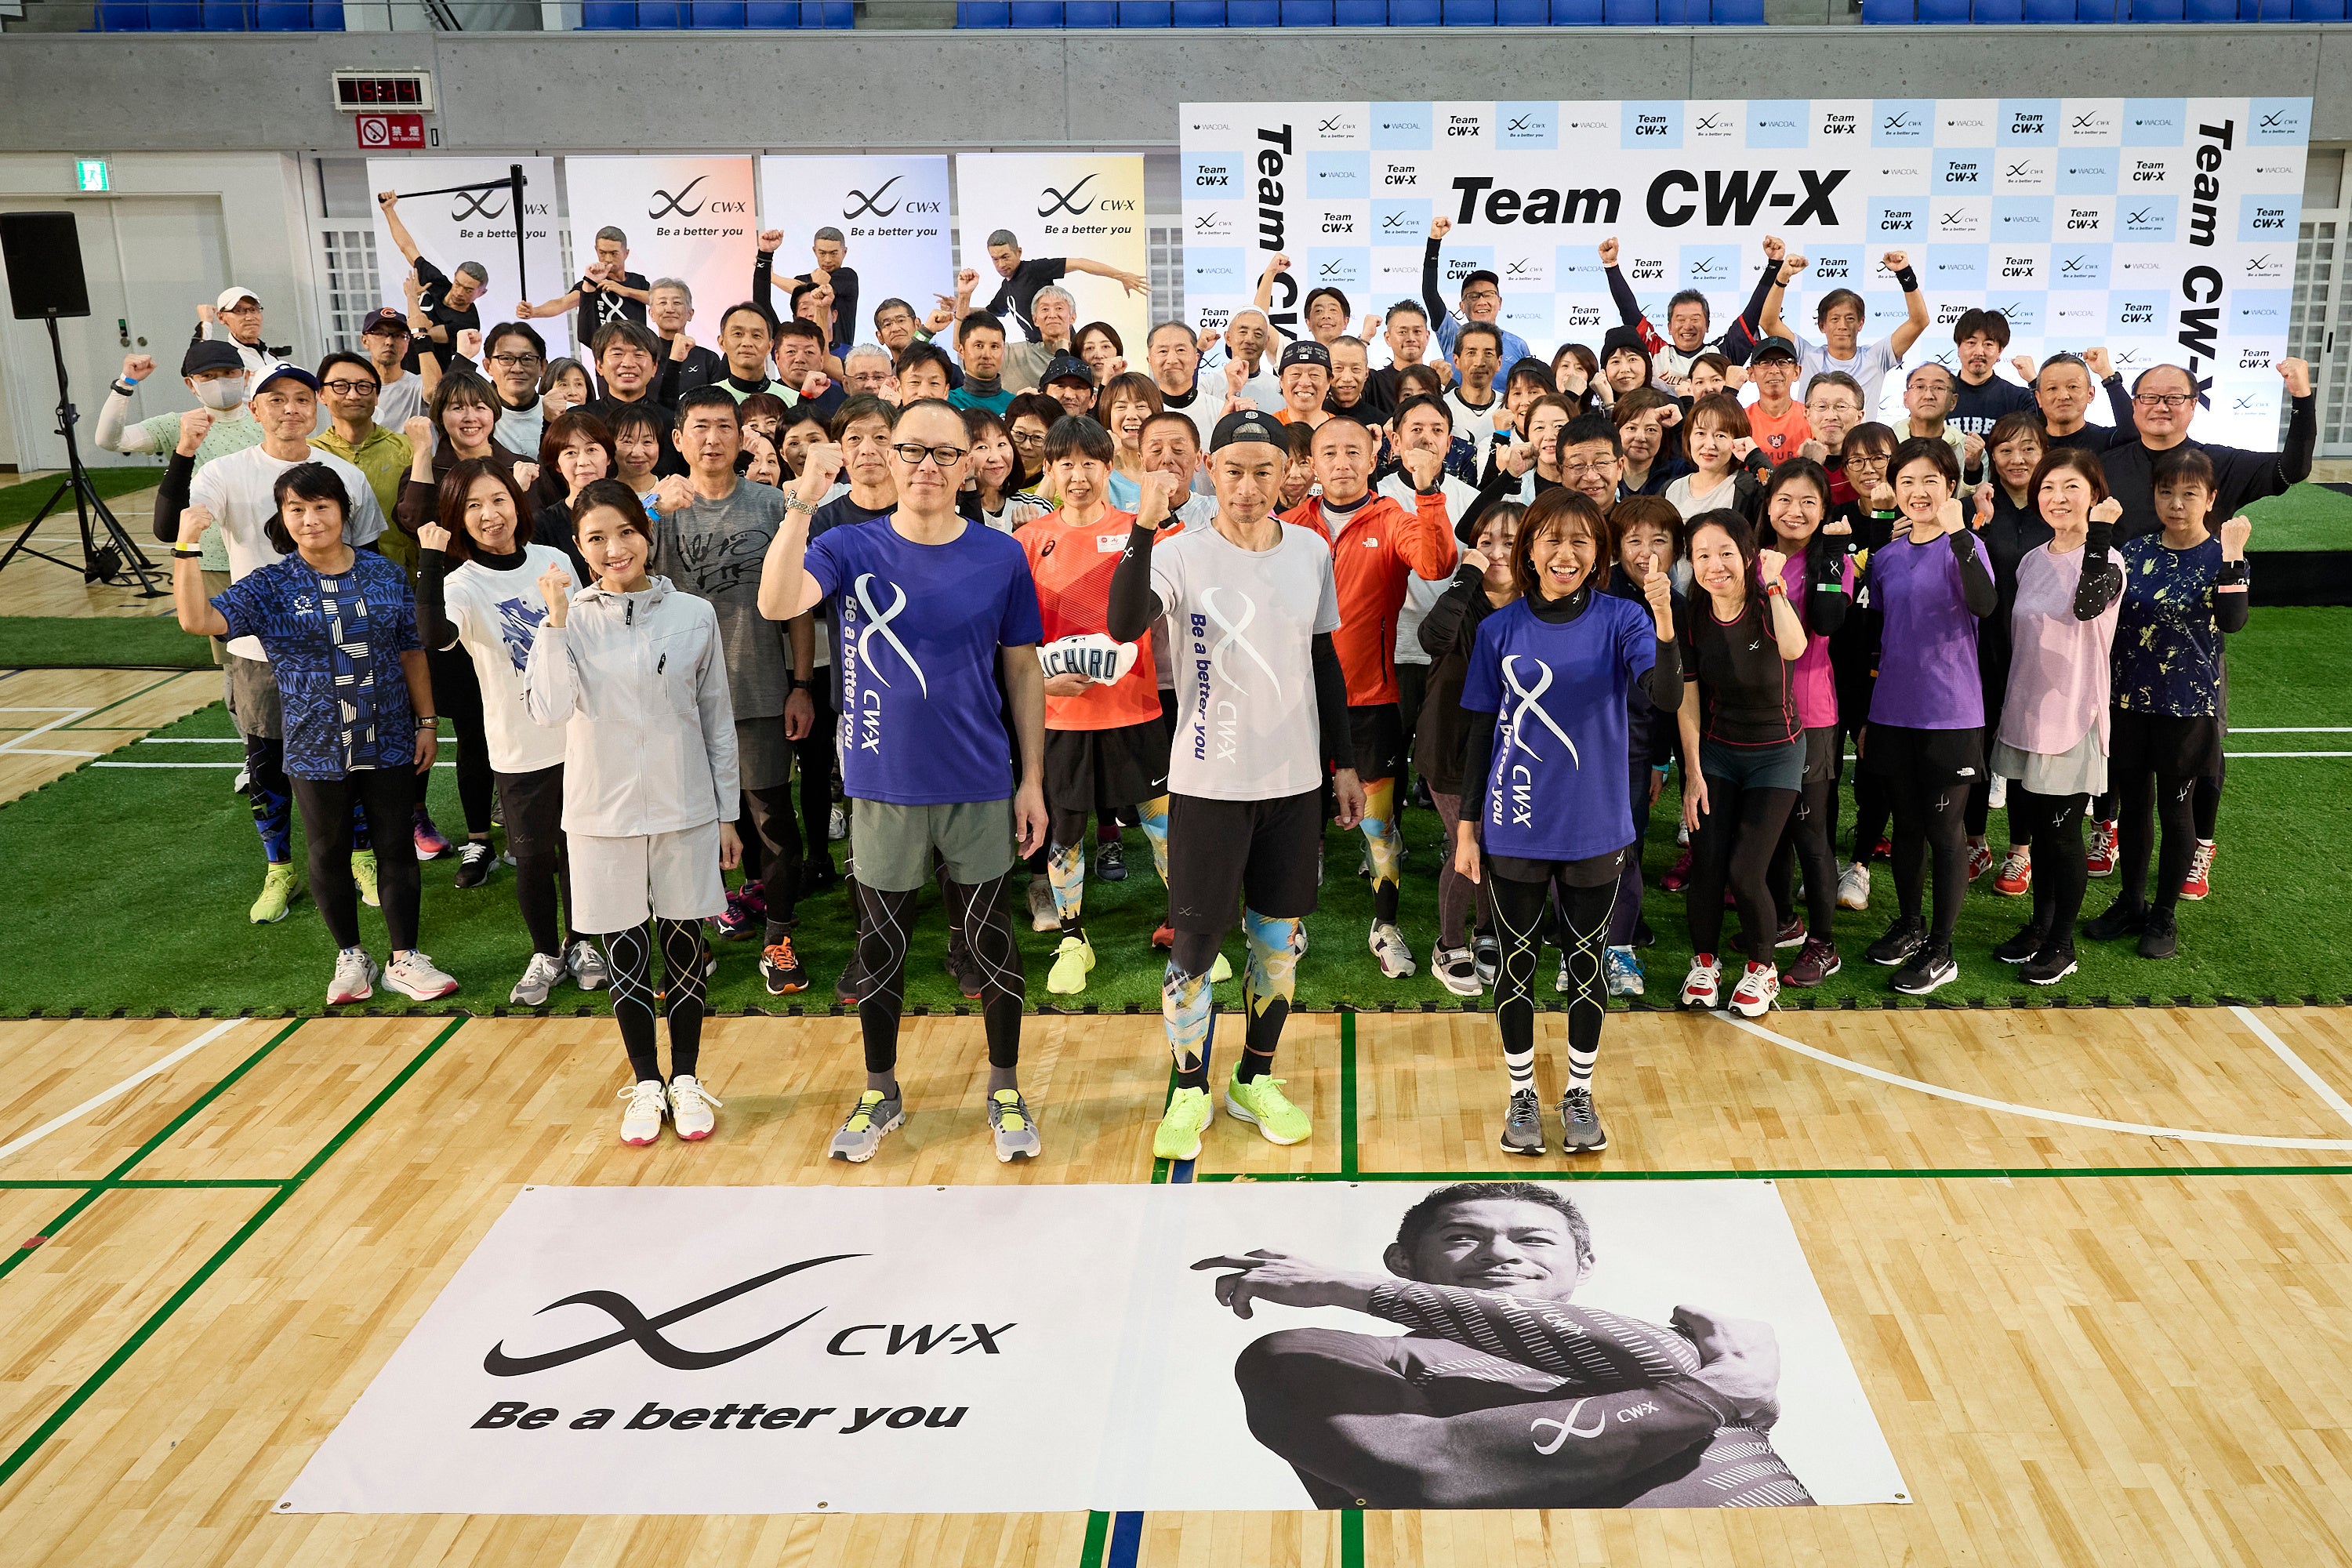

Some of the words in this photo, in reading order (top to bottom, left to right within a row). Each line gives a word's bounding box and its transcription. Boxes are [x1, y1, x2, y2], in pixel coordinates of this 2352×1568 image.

[1448, 127, 1479, 136] CW-X
[1635, 125, 1668, 135] CW-X
[1824, 125, 1856, 133] CW-X
[2012, 124, 2045, 133] CW-X
[1196, 176, 1229, 185] CW-X
[1385, 176, 1417, 184] CW-X
[1946, 172, 1978, 182] CW-X
[2133, 172, 2165, 180] CW-X
[1258, 124, 1291, 251] Team
[2190, 120, 2234, 246] Team
[1452, 177, 1621, 225] Team
[1646, 170, 1851, 227] CW-X
[524, 204, 548, 214] W-X
[712, 202, 746, 212] CW-X
[906, 202, 940, 212] CW-X
[1101, 200, 1134, 210] CW-X
[1322, 223, 1353, 232] CW-X
[1882, 220, 1913, 230] CW-X
[2067, 220, 2099, 229] CW-X
[2253, 219, 2285, 228] CW-X
[460, 229, 474, 238] Be
[487, 229, 517, 238] bette
[1632, 270, 1664, 278] CW-X
[1817, 269, 1849, 278] CW-X
[2002, 268, 2034, 277] CW-X
[1570, 317, 1600, 325] CW-X
[2122, 314, 2153, 322] CW-X
[1856, 585, 1869, 608] 4
[845, 595, 857, 622] Be
[1191, 613, 1206, 638] Be
[845, 626, 855, 639] a
[1194, 643, 1206, 654] a
[1043, 648, 1117, 680] ICHIRO
[844, 643, 857, 709] better
[1196, 659, 1211, 720] better
[861, 689, 880, 755] CW-X
[843, 710, 855, 750] you
[1217, 701, 1237, 764] CW-X
[1195, 722, 1206, 760] you
[1512, 765, 1532, 829] CW-X
[1492, 787, 1503, 826] you
[826, 1322, 1017, 1357] CW-X
[1616, 1400, 1661, 1424] CW-X
[470, 1401, 559, 1429] Be
[569, 1408, 615, 1430] a
[623, 1402, 837, 1430] better
[838, 1406, 970, 1434] you
